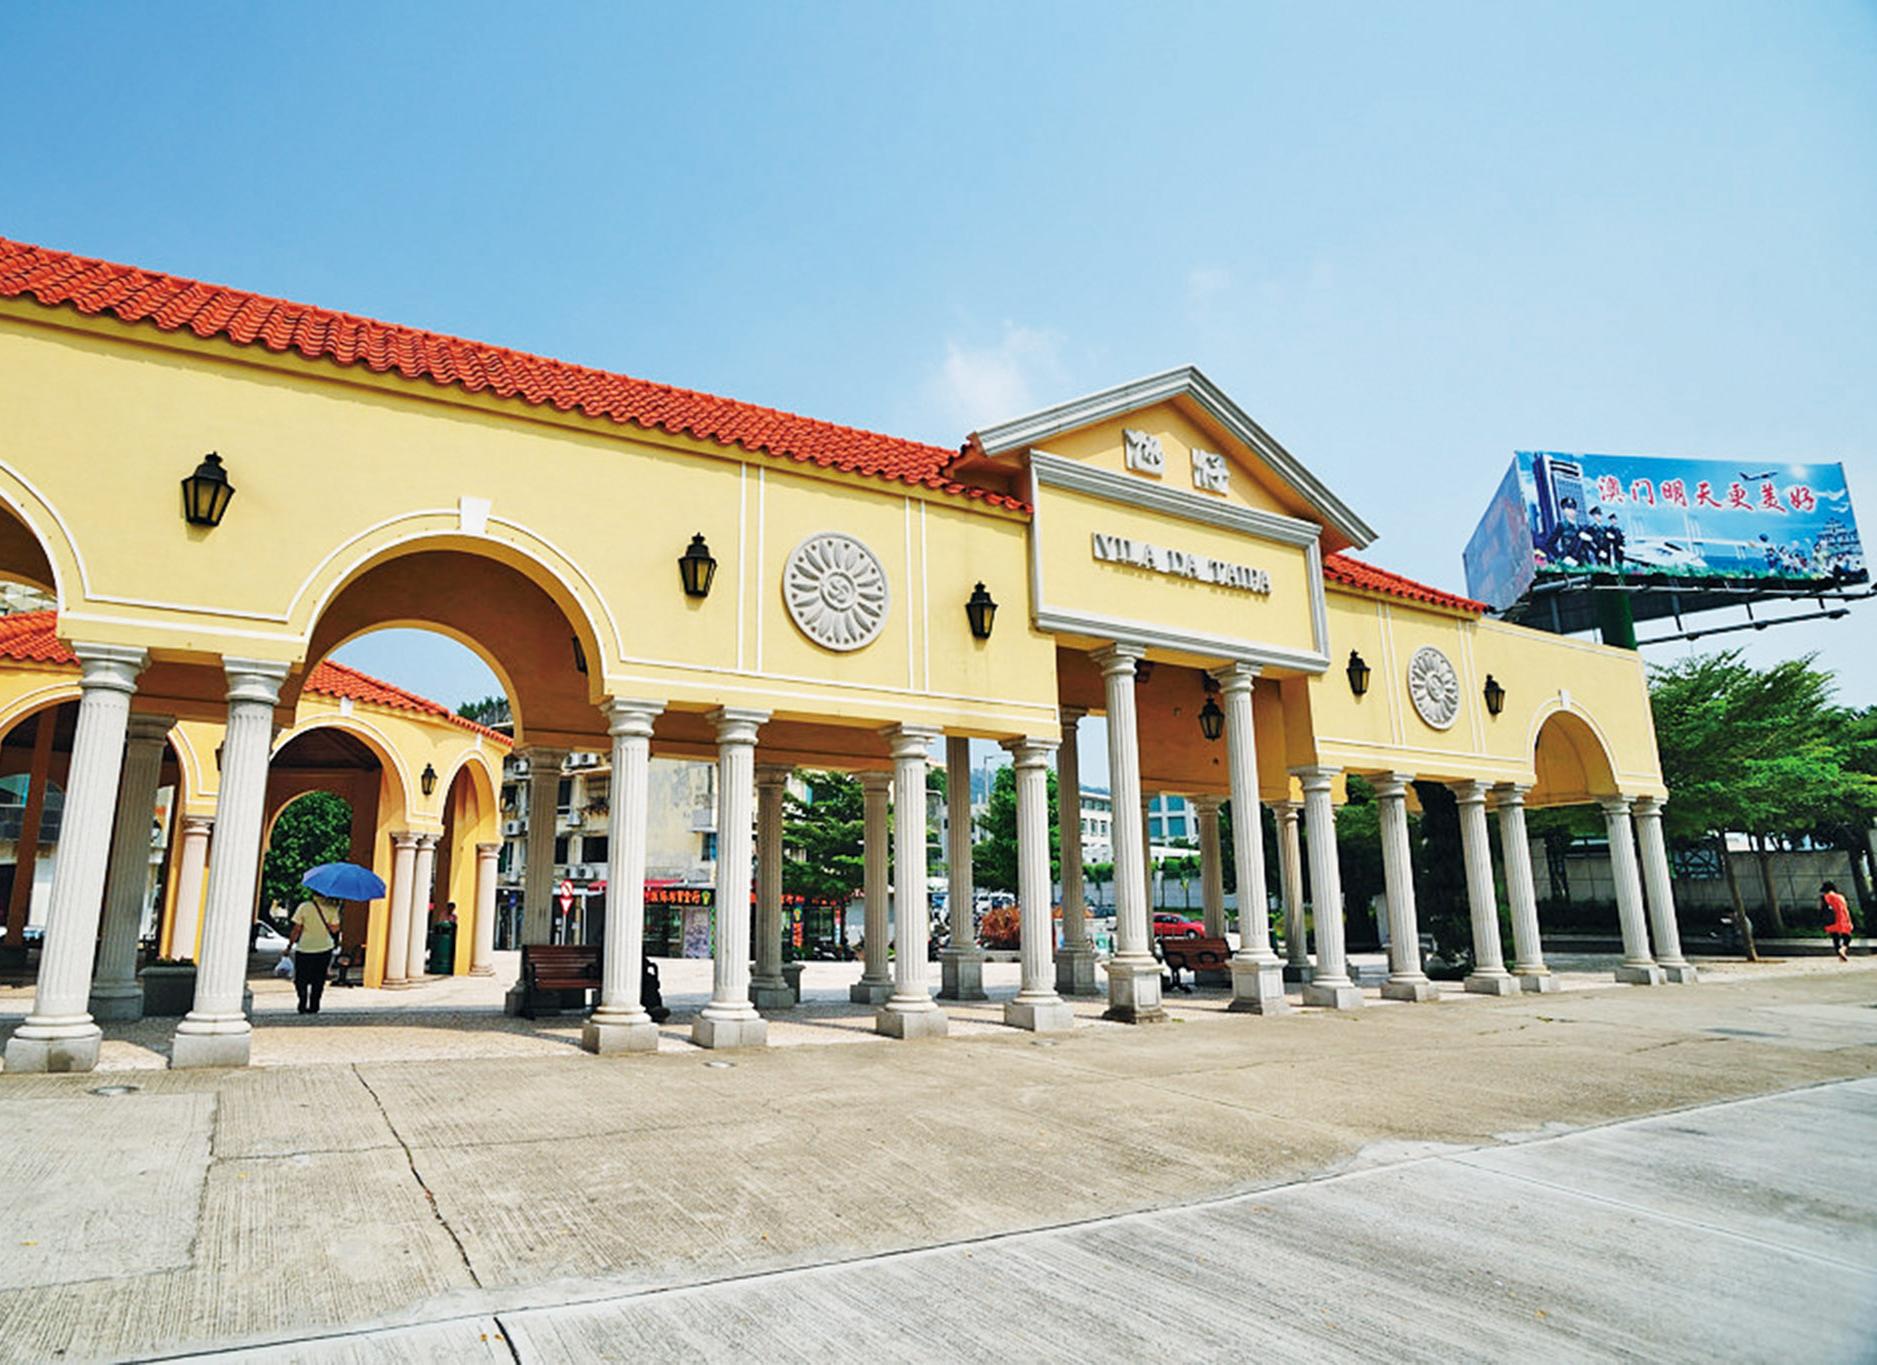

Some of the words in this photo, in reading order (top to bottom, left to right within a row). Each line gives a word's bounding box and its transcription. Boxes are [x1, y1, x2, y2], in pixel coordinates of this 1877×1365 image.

[1598, 474, 1816, 513] 澳门明天更美好
[1092, 532, 1156, 570] VILA
[1163, 548, 1199, 580] DA
[1209, 559, 1271, 596] TAIPA
